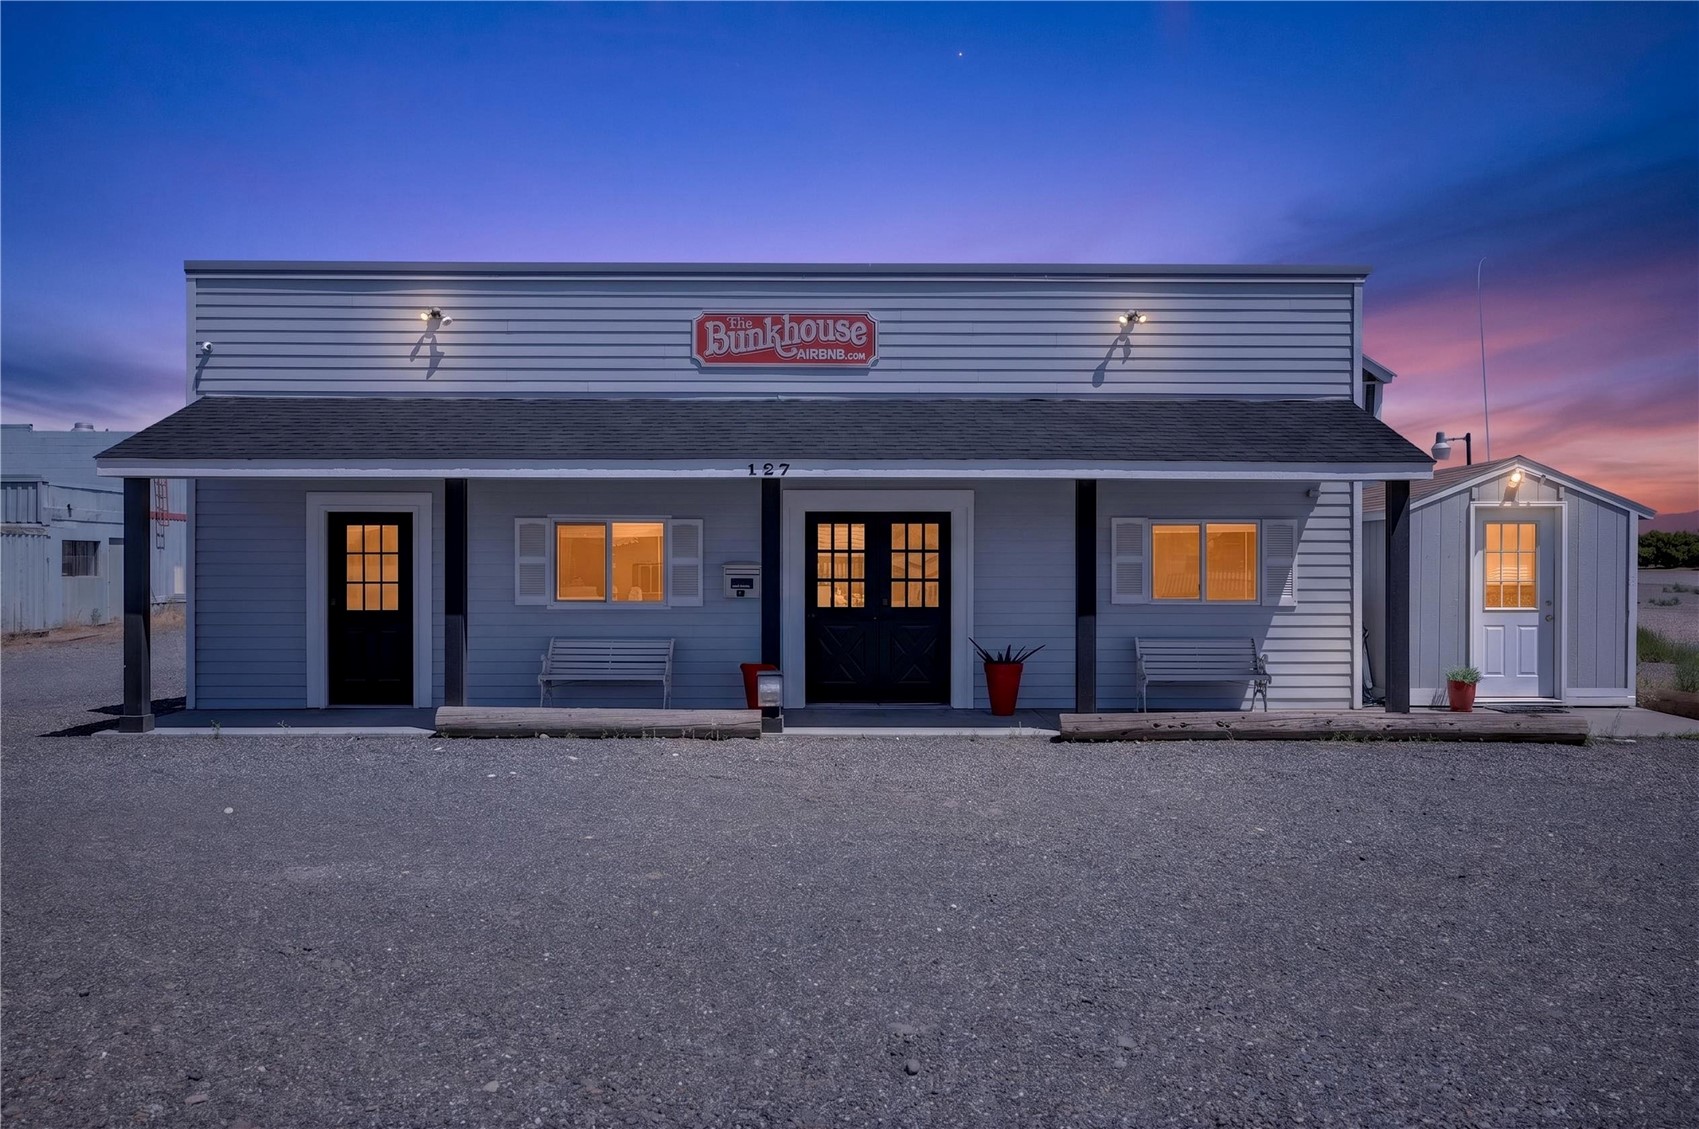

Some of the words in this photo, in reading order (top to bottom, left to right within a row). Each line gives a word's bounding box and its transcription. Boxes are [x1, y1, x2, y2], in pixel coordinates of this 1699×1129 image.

[727, 317, 752, 329] The
[704, 315, 867, 358] Bunkhouse
[797, 348, 865, 360] AIRBNB.COM
[748, 463, 790, 476] 127
